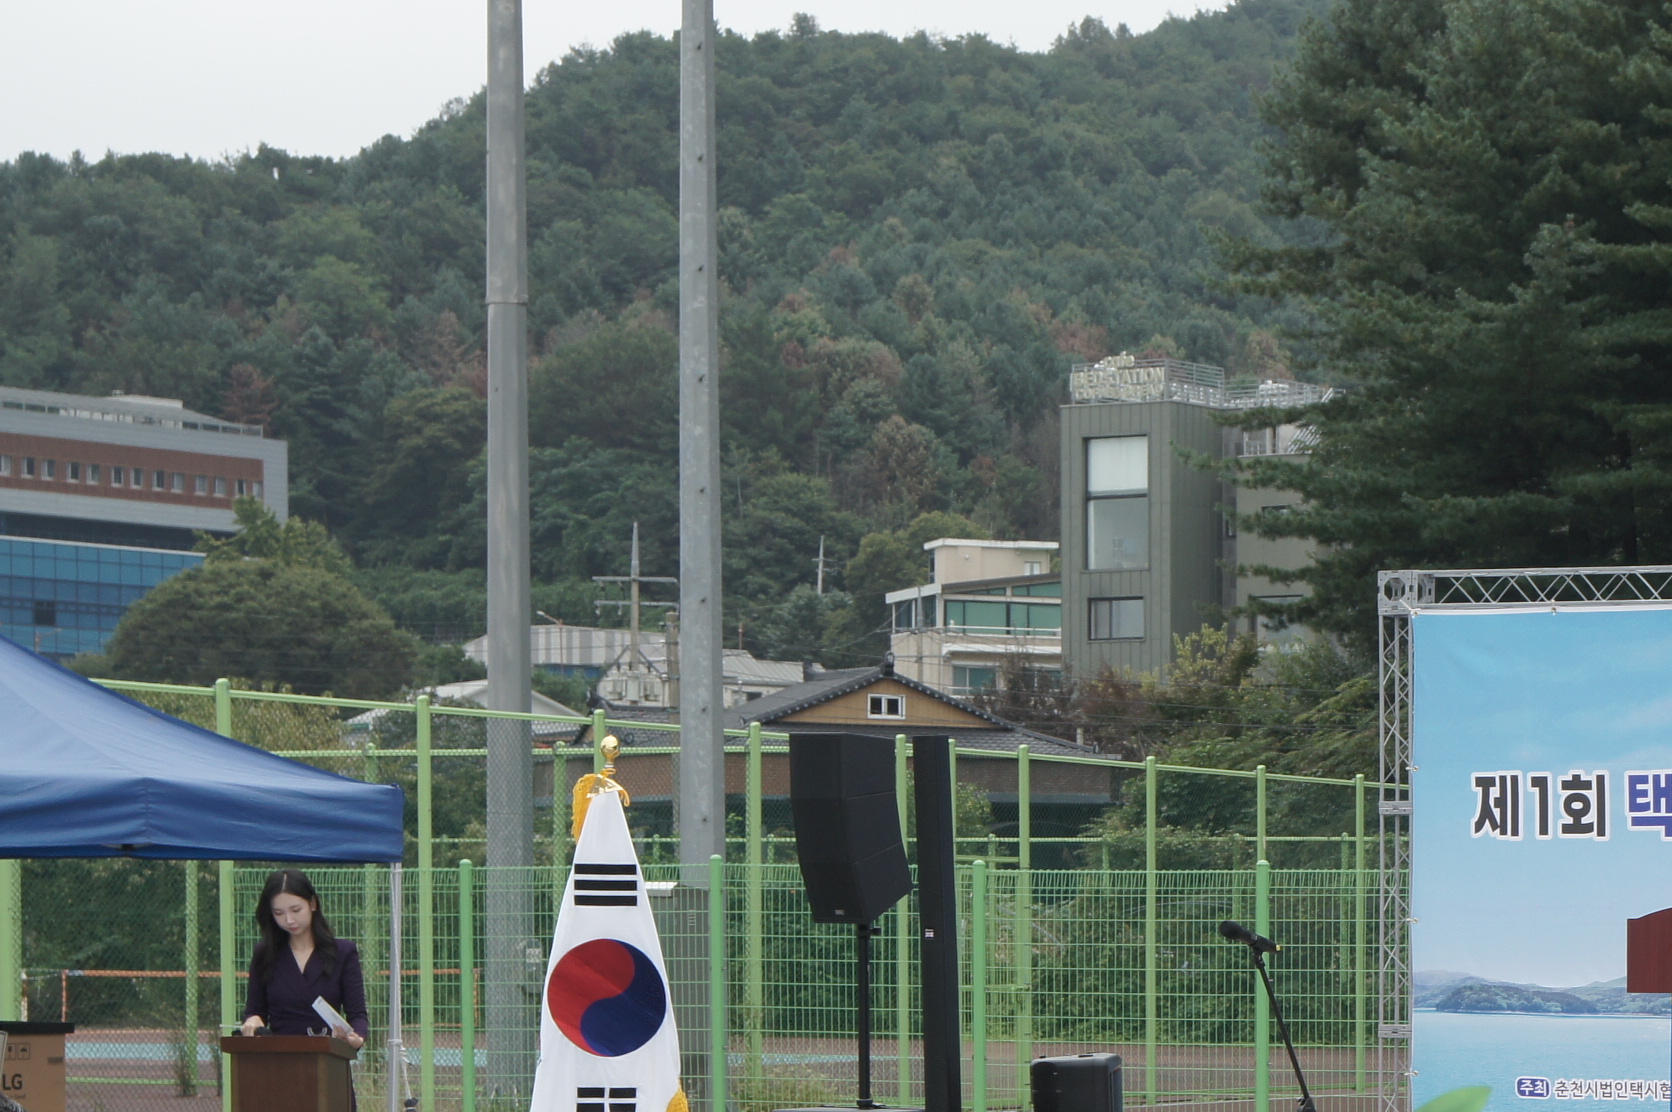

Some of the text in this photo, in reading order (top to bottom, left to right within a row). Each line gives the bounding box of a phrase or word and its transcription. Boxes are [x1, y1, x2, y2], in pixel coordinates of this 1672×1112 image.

[1473, 773, 1607, 839] 제1회
[2, 1073, 24, 1091] LG
[1519, 1079, 1672, 1100] 주최 춘천시법인택시협
